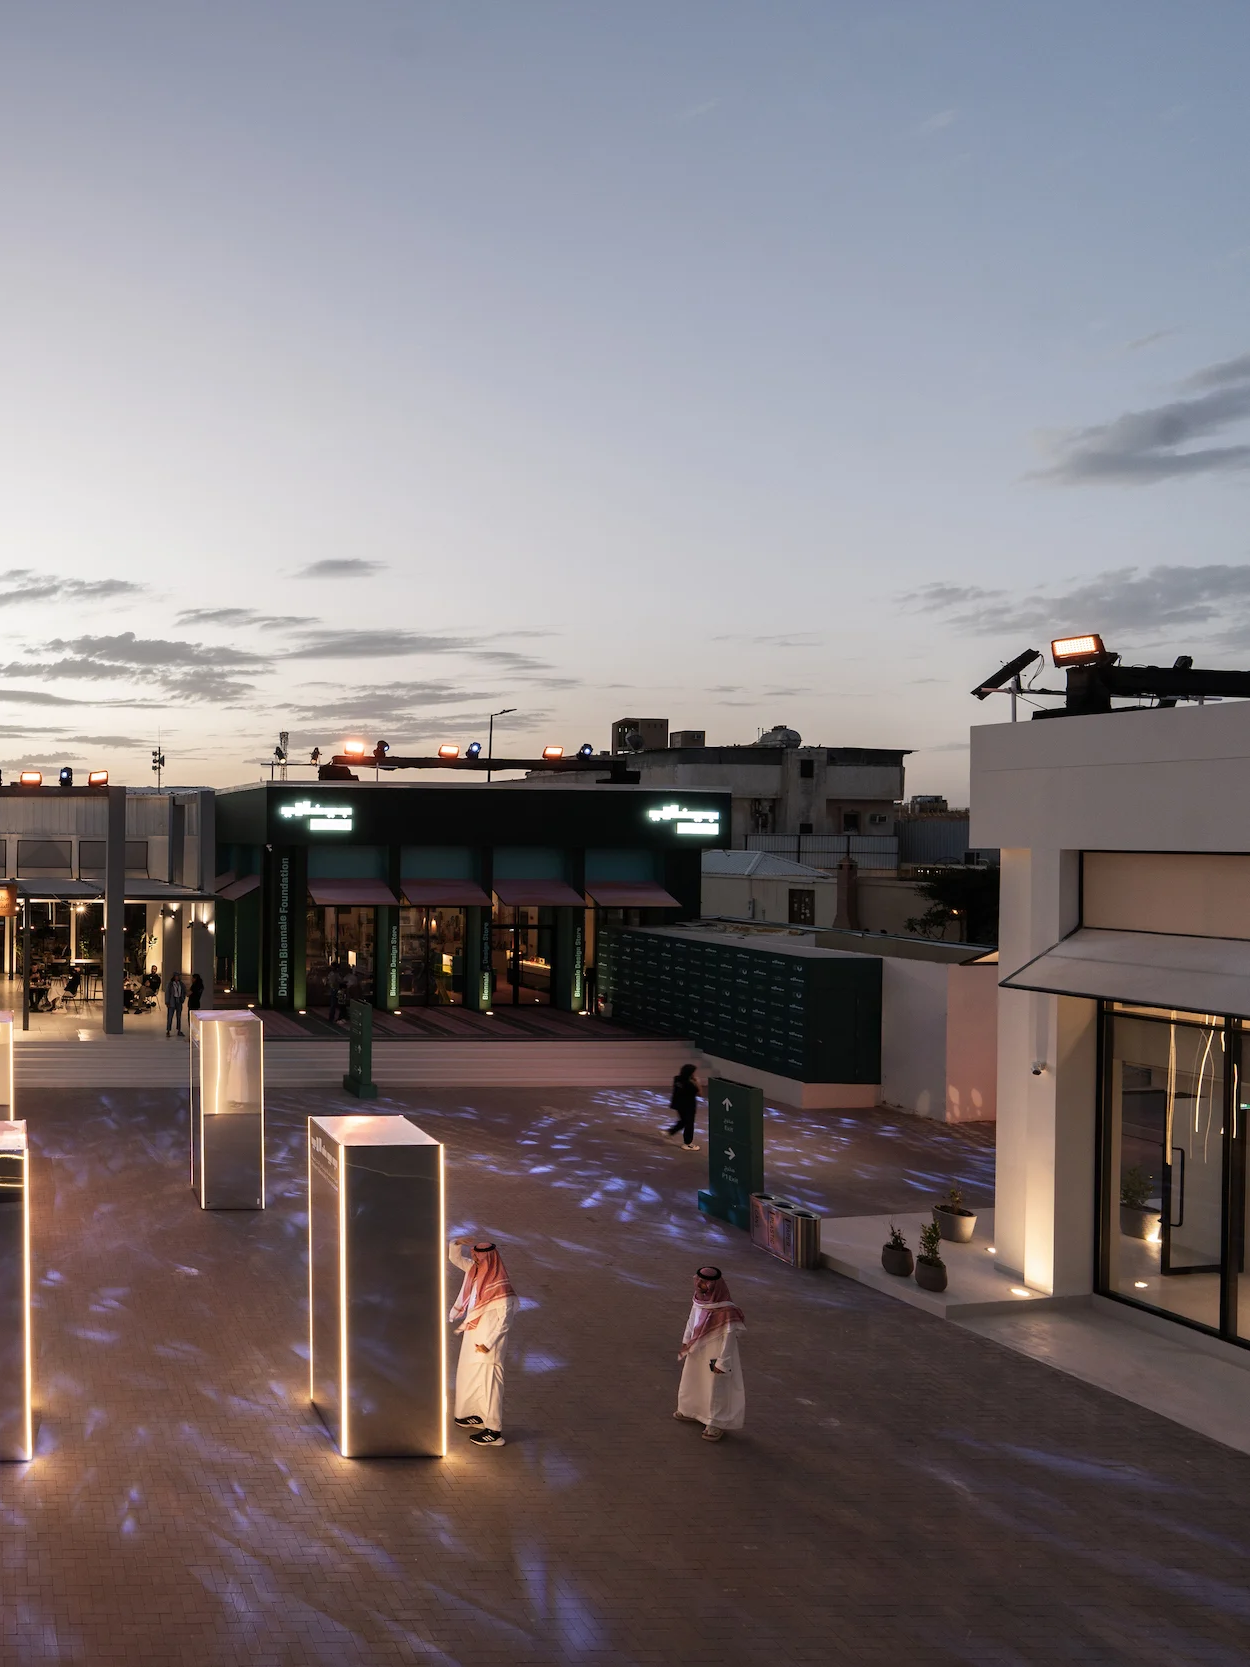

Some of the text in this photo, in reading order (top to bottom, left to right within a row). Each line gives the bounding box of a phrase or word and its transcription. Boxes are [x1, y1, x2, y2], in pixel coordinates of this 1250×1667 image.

[278, 857, 289, 997] Diriyah Biennale Foundation
[390, 945, 398, 968] Design
[724, 1125, 734, 1133] Exit
[729, 1174, 739, 1185] Exit
